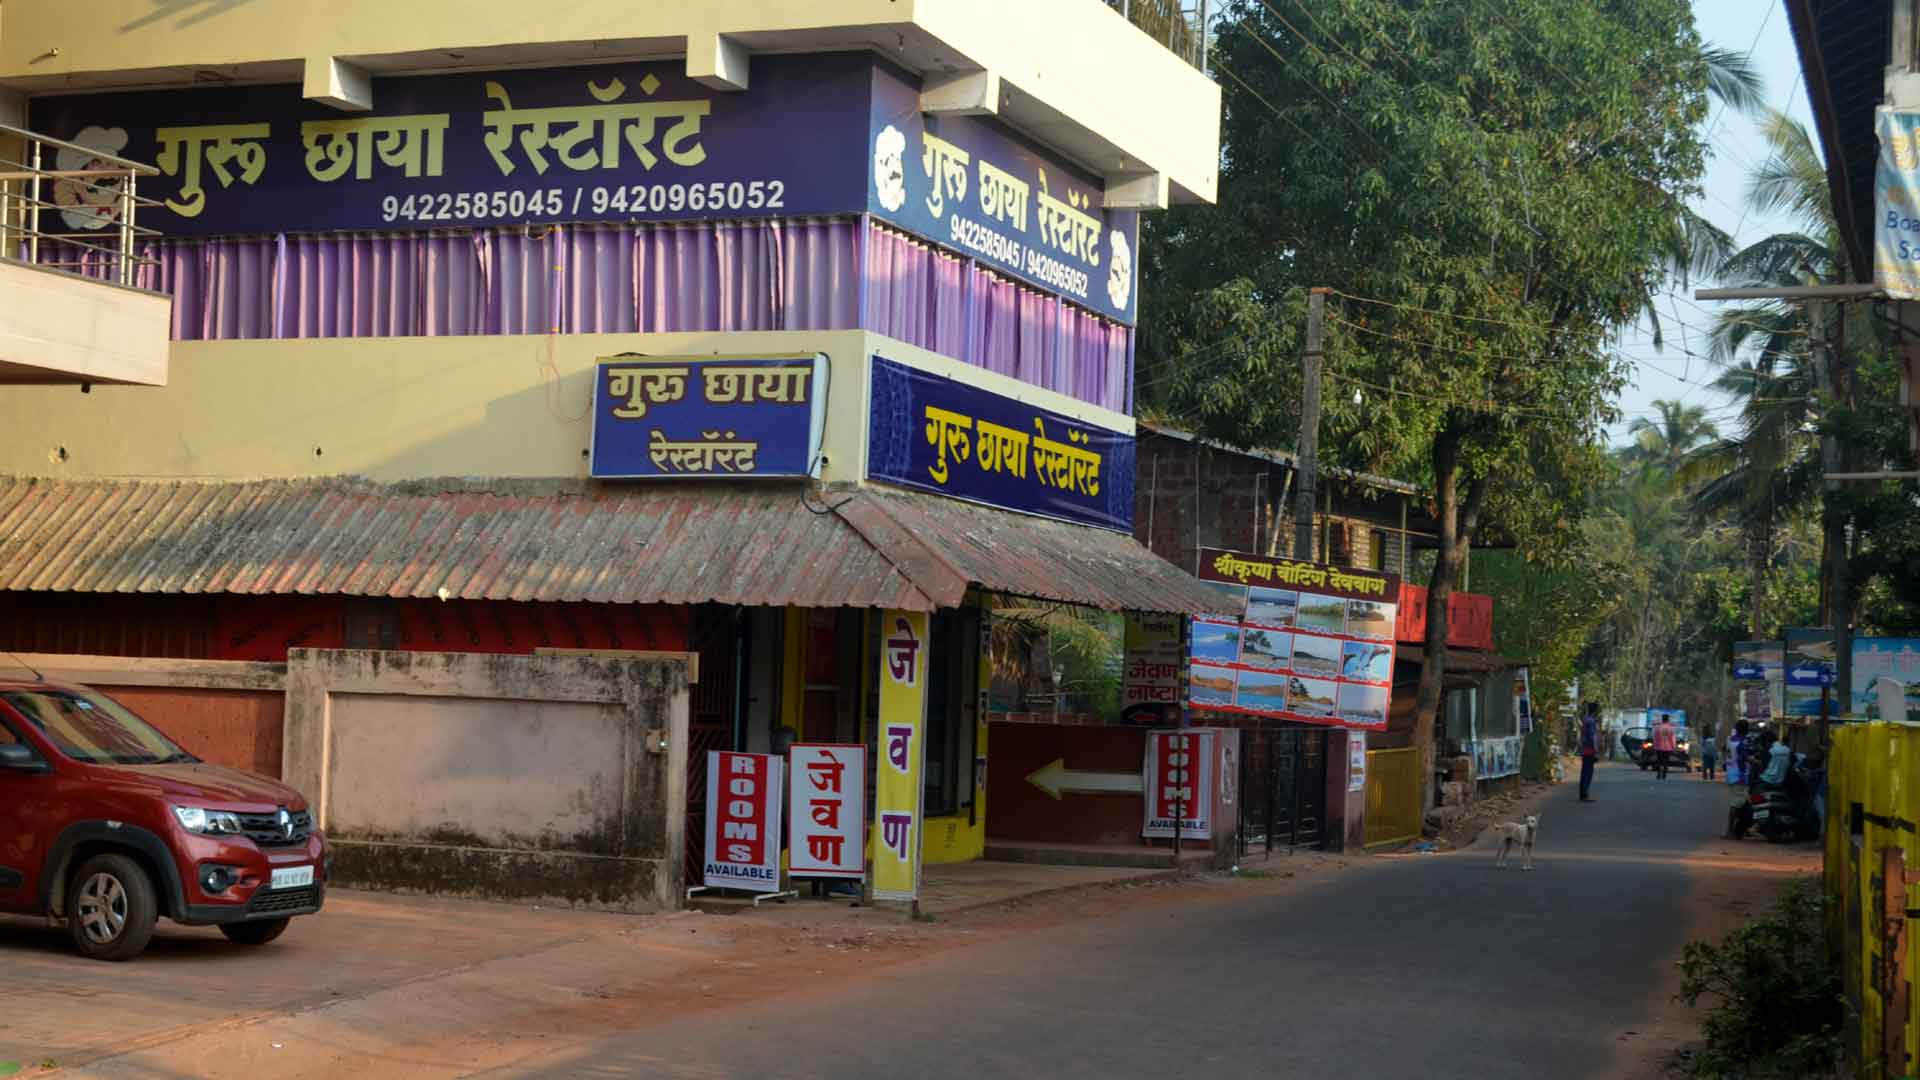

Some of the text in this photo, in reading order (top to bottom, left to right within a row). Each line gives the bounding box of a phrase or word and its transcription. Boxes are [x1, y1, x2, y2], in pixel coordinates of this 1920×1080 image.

[301, 113, 450, 183] छाया
[483, 80, 711, 176] रेस्टॉरंट
[382, 180, 785, 223] 9422585045 / 9420965052
[978, 159, 1030, 233] छाया
[1037, 166, 1102, 267] रेस्टॉरंट
[950, 213, 1089, 298] 9422585045 / 9420965052
[607, 366, 812, 419] गुरु छाया
[648, 430, 758, 472] रेस्टॉरंट
[925, 405, 1101, 497] गुरु छाया रेस्टॉरंट
[724, 755, 757, 863] ROOMS
[1164, 735, 1192, 817] ROOMS
[1150, 820, 1208, 829] AVAIABLE
[706, 863, 774, 880] AVAILABLE
